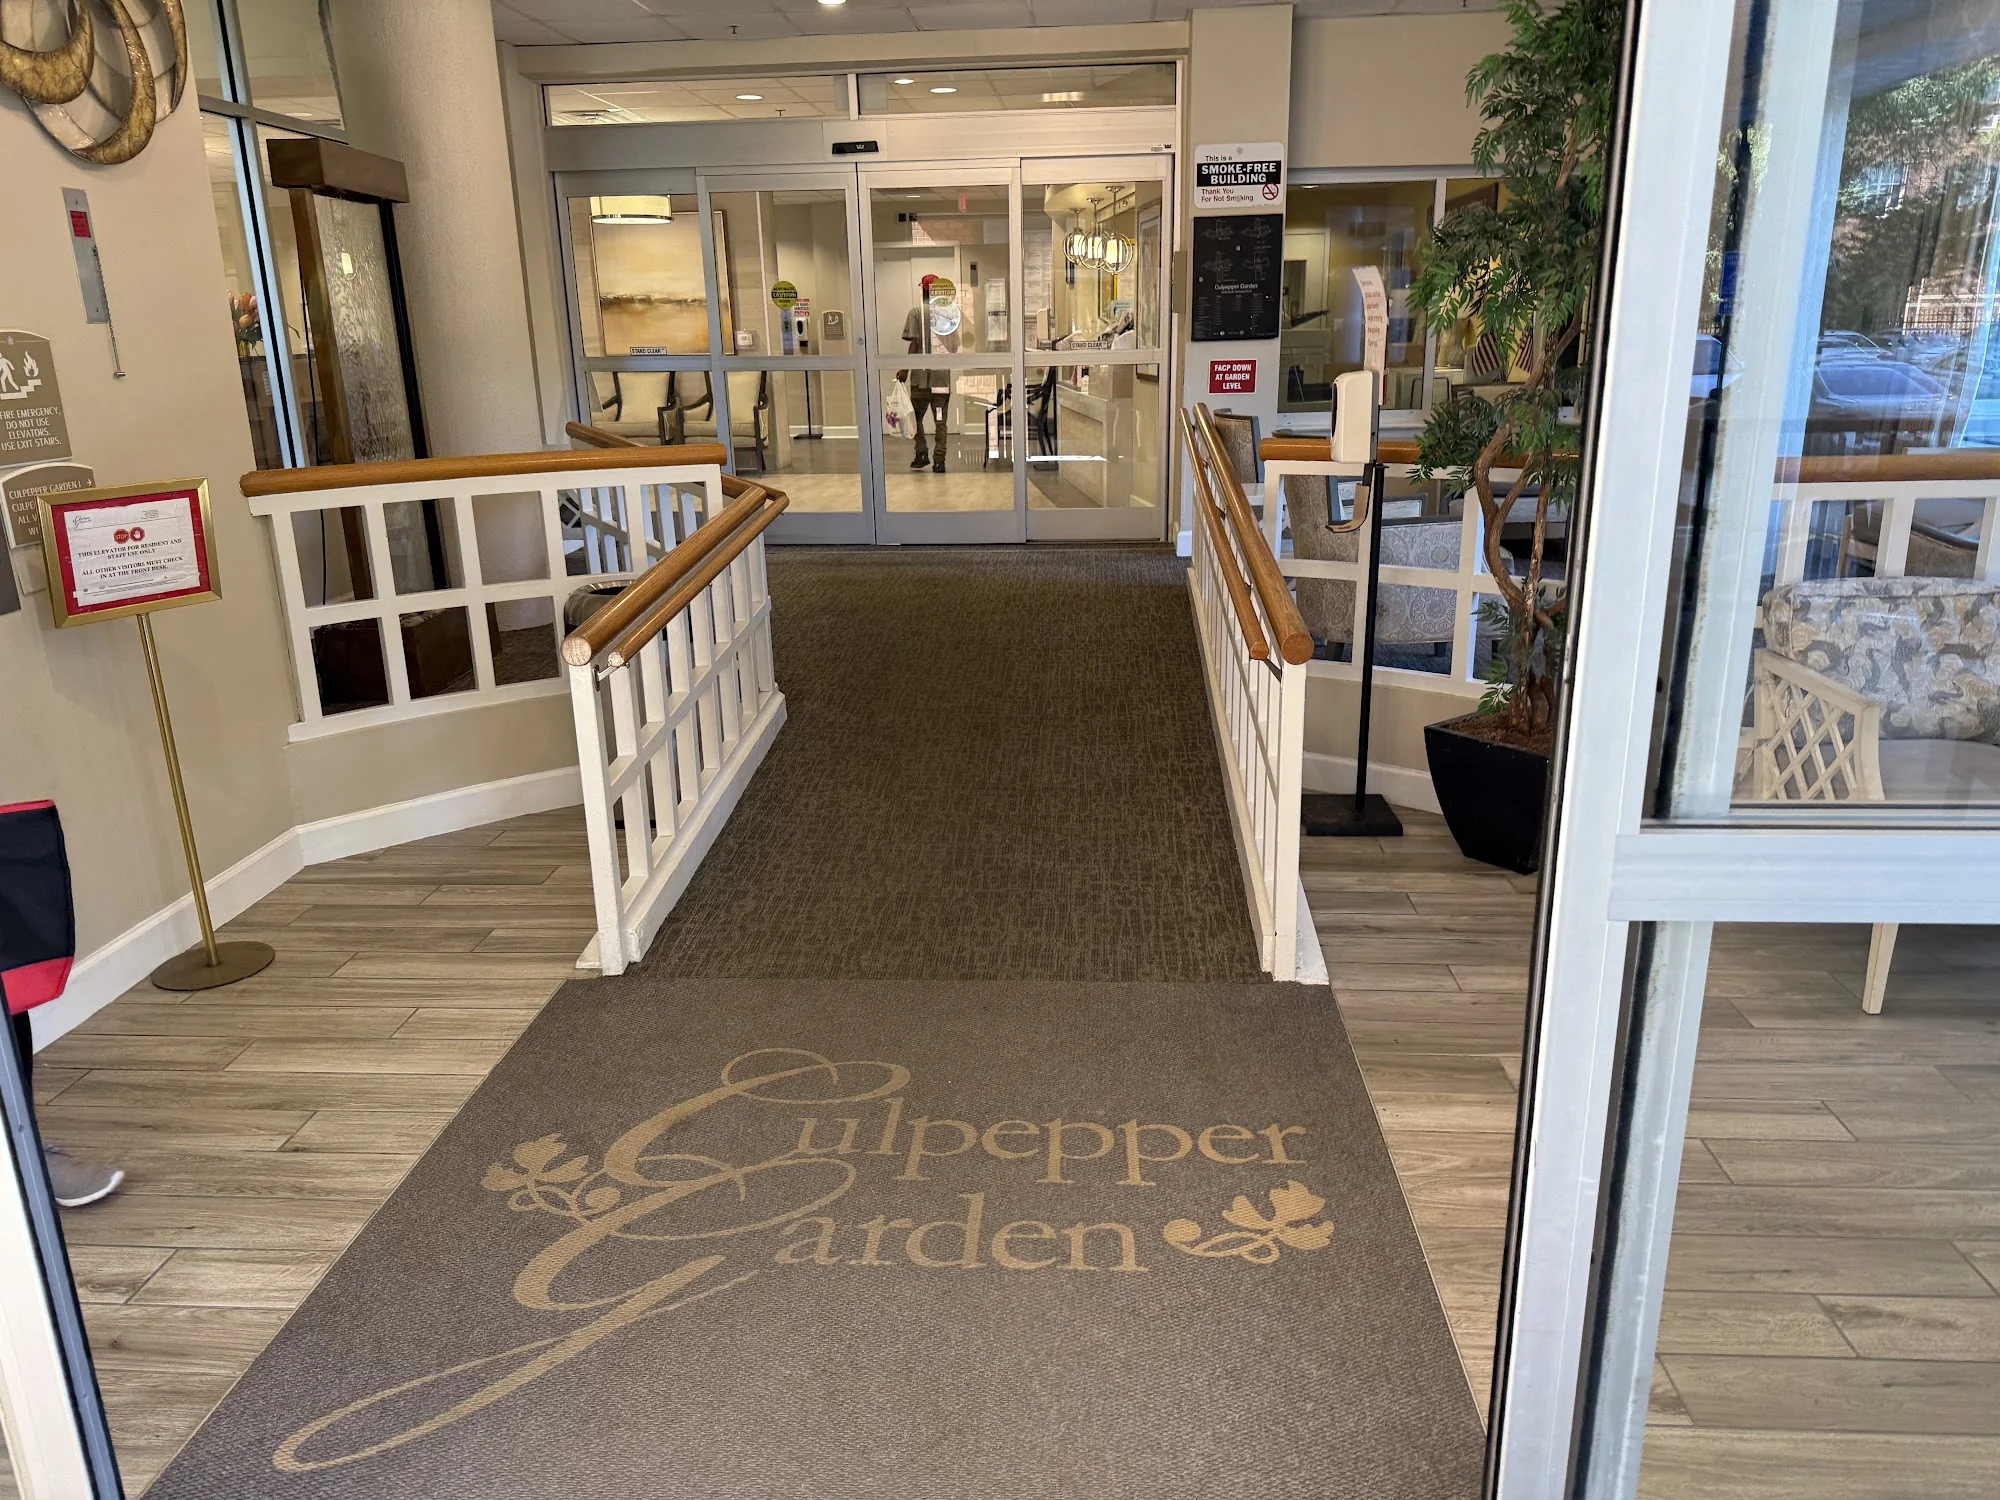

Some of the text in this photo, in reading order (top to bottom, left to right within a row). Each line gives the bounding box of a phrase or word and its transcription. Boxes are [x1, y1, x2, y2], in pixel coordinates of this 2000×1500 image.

[1201, 163, 1277, 175] SMOKE-FREE
[1210, 173, 1267, 184] BUILDING
[6, 417, 50, 430] DO NOT USE
[1, 436, 62, 451] USE EXIT STAIRS.
[49, 481, 76, 493] GARDEN
[18, 515, 31, 525] ALL
[115, 533, 128, 541] STOP
[94, 546, 126, 556] ELEVATOR
[141, 540, 169, 549] RESIDENT
[96, 566, 117, 574] OTHER
[118, 562, 145, 570] VISITORS
[146, 559, 162, 567] MUST
[163, 556, 184, 564] CHECK
[131, 567, 151, 575] FRONT
[603, 1047, 1307, 1188] Culpepper
[272, 1156, 1150, 1473] Garden
